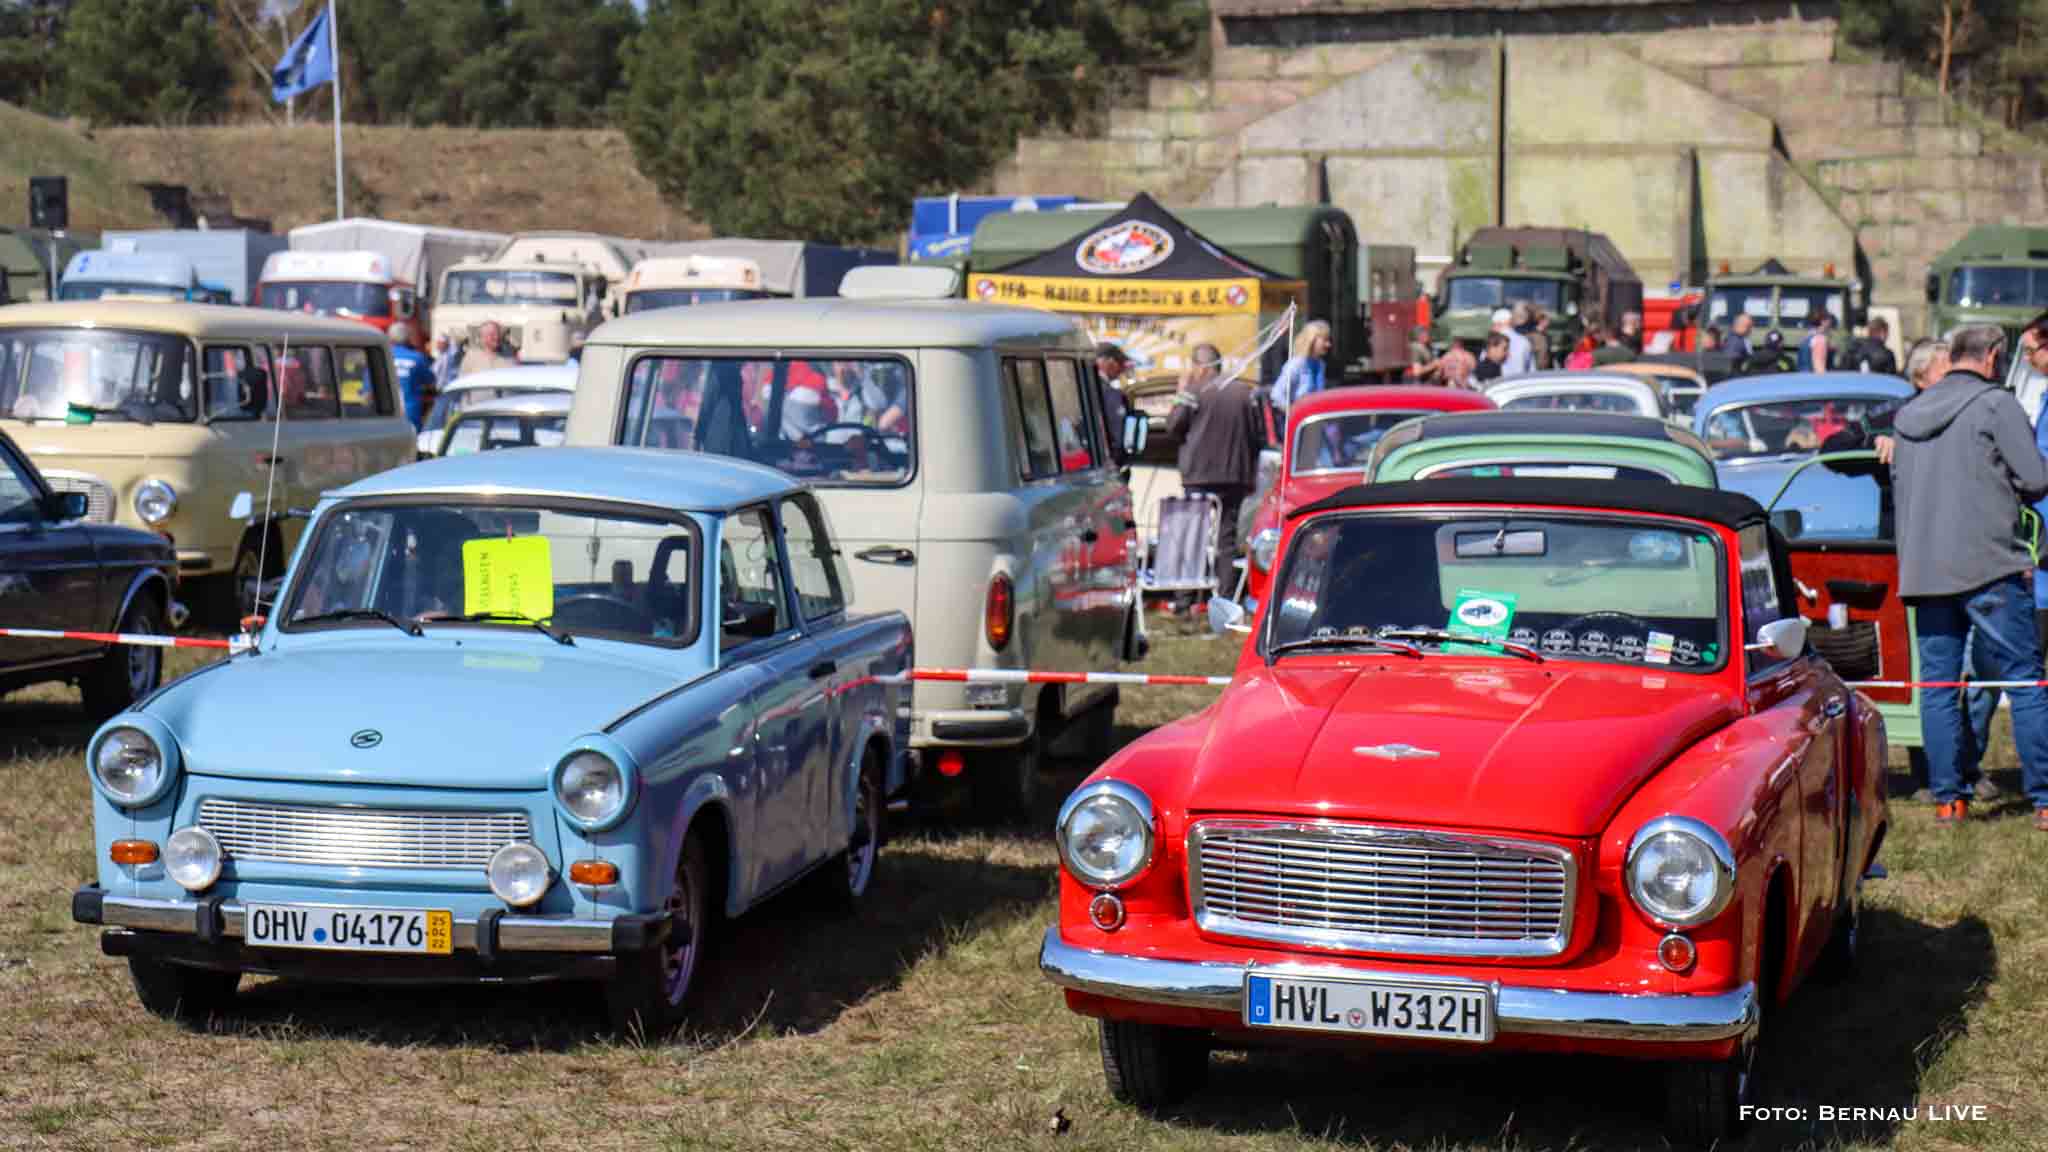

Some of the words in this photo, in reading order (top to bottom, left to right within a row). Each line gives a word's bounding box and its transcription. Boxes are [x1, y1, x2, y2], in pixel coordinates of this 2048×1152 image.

[253, 909, 307, 941] OHV
[332, 913, 424, 946] 04176
[1275, 984, 1340, 1023] HVL
[1371, 991, 1482, 1034] W312H
